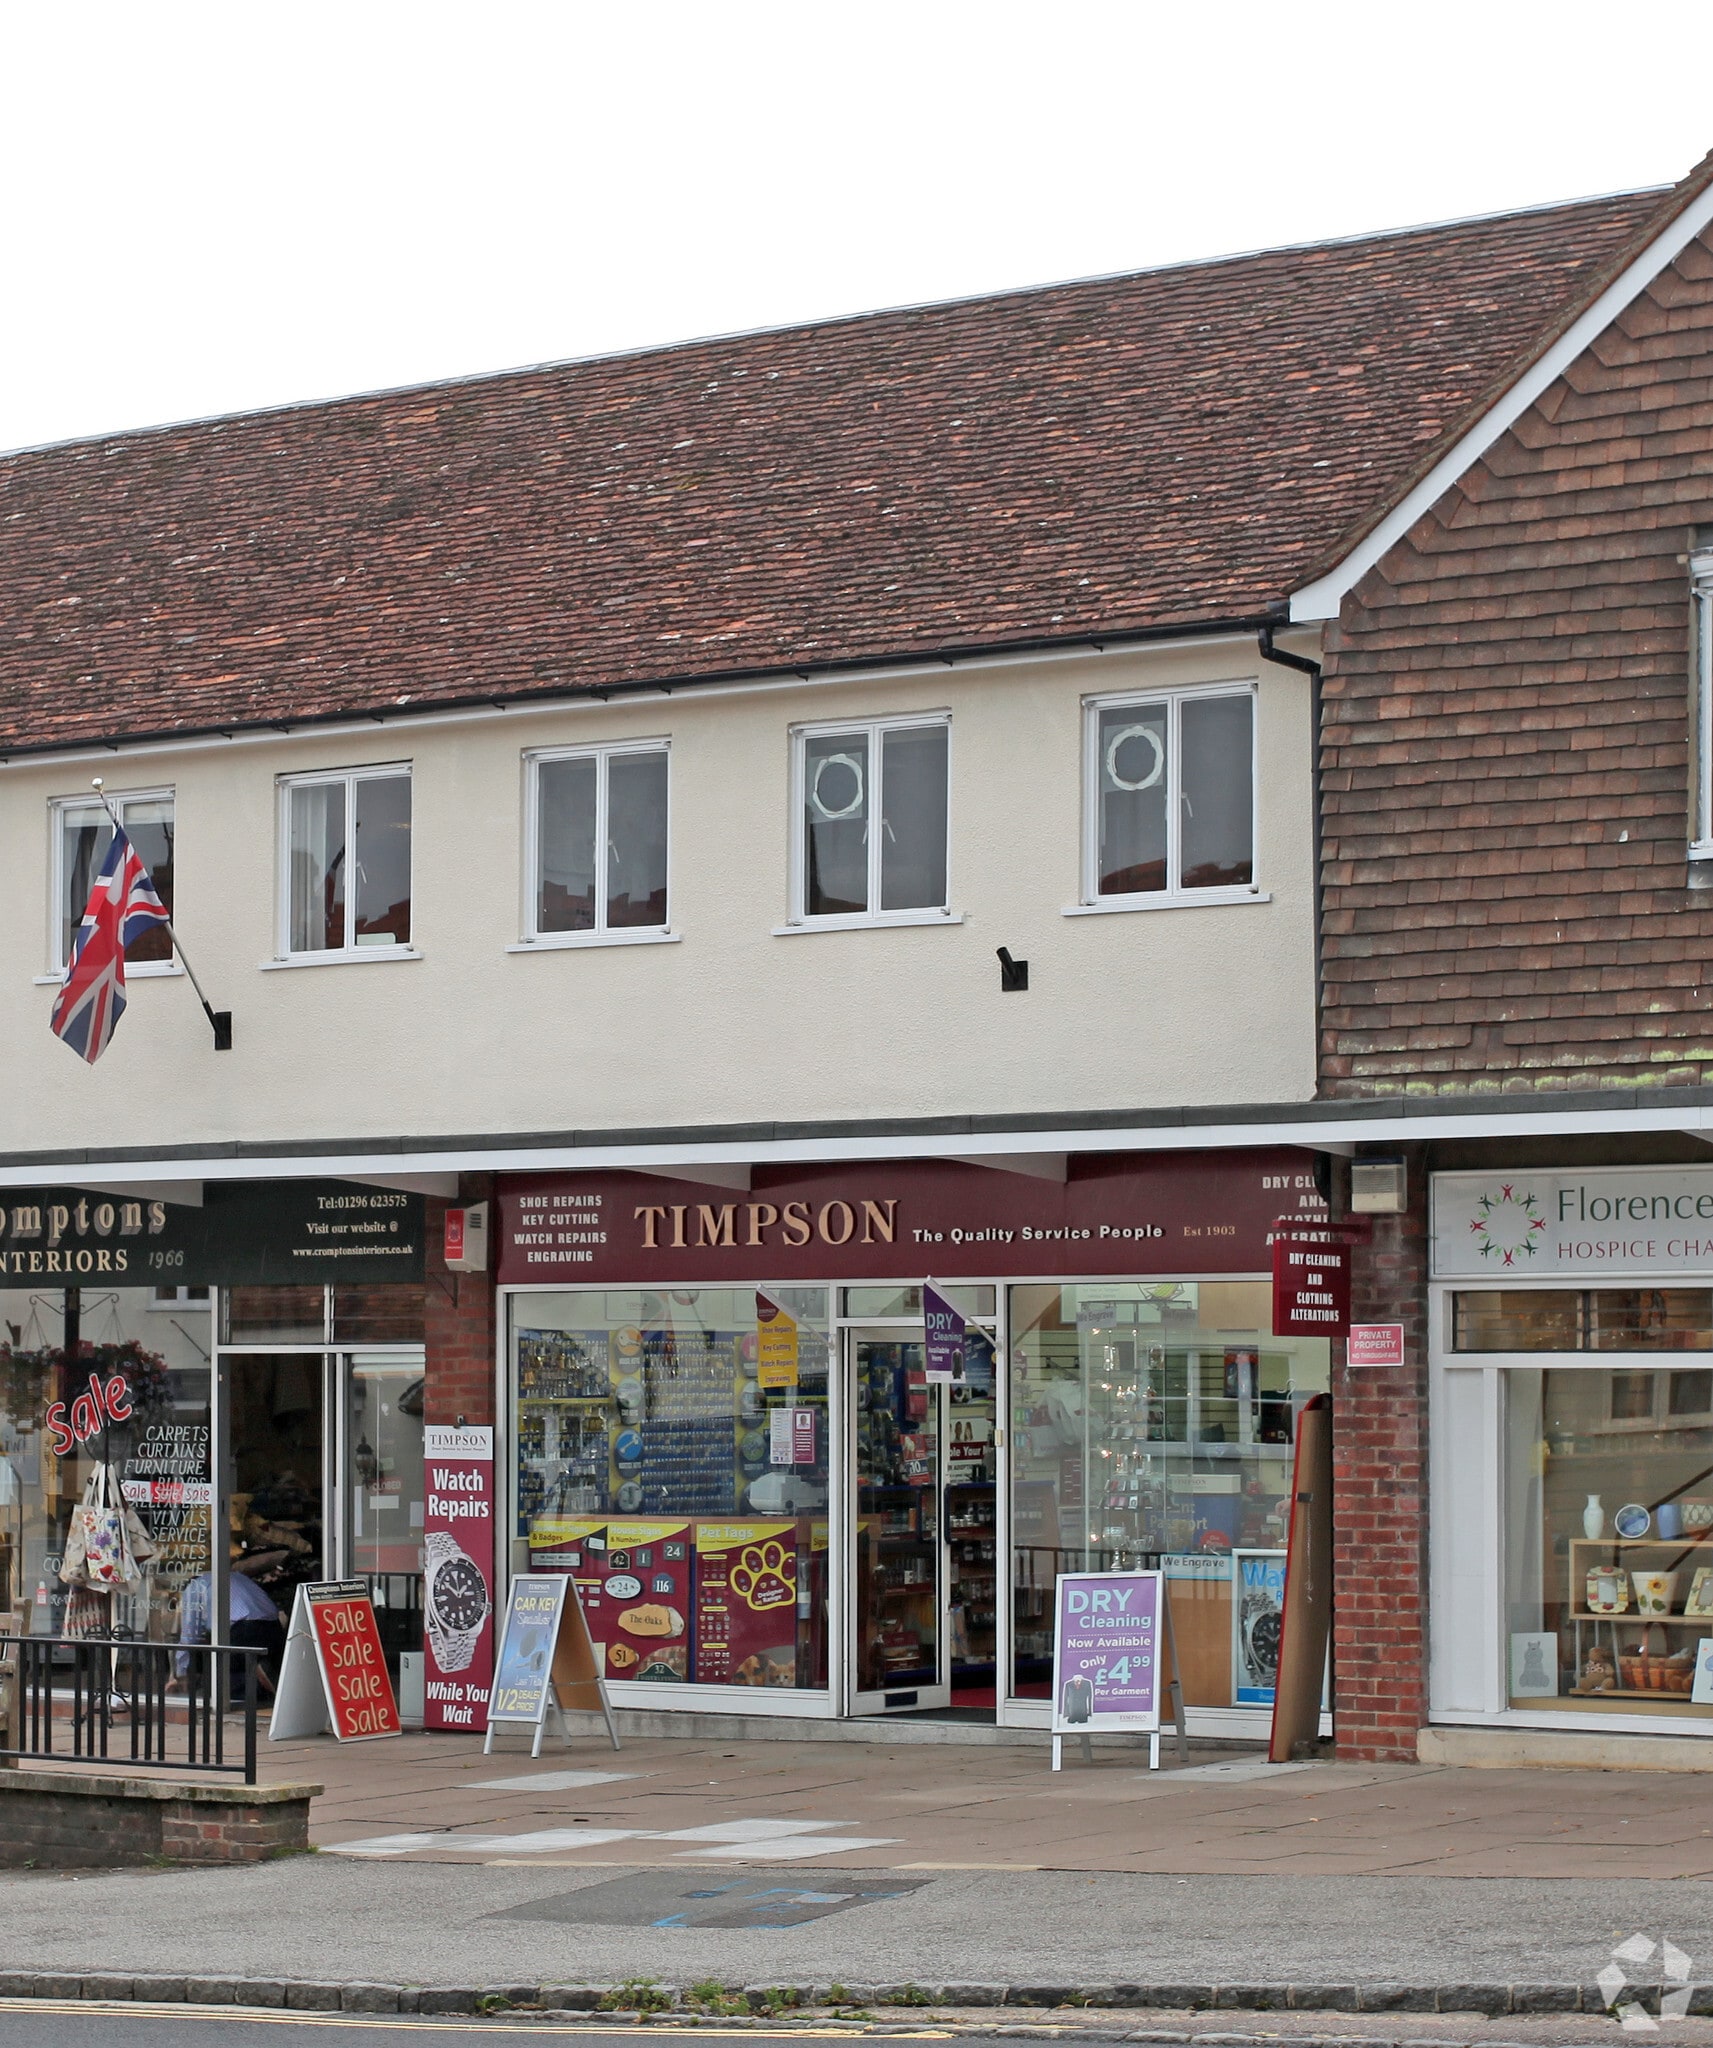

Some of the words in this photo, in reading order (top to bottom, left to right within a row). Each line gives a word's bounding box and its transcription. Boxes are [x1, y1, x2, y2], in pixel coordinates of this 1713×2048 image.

[1262, 1176, 1290, 1189] DRY
[317, 1196, 368, 1209] Tel:01296
[370, 1195, 408, 1207] 623575
[520, 1197, 548, 1208] SHOE
[553, 1195, 602, 1207] REPAIRS
[1558, 1186, 1713, 1222] Florence
[522, 1214, 544, 1225] KEY
[550, 1213, 599, 1225] CUTTING
[633, 1200, 900, 1248] TIMPSON
[306, 1222, 329, 1234] Visit
[331, 1224, 348, 1234] our
[350, 1221, 386, 1233] website
[389, 1220, 398, 1233] @
[913, 1229, 943, 1242] The
[951, 1228, 1014, 1244] Quality
[1022, 1227, 1091, 1240] Service
[1100, 1224, 1163, 1241] People
[1183, 1226, 1201, 1237] Est
[1205, 1225, 1236, 1236] 1903
[514, 1233, 552, 1244] WATCH
[558, 1232, 607, 1243] REPAIRS
[292, 1245, 413, 1258] www.cromptonsinteriors.co.uk
[1558, 1240, 1656, 1259] HOSPICE
[1667, 1239, 1713, 1258] CHA
[150, 1250, 184, 1269] 1966
[528, 1251, 593, 1262] ENGRAVING
[1289, 1253, 1304, 1265] DRY
[1306, 1254, 1341, 1267] CLEANING
[1307, 1273, 1323, 1285] AND
[1297, 1292, 1333, 1305] CLOTHING
[927, 1313, 953, 1330] DRY
[1290, 1309, 1339, 1322] ALTERATIONS
[933, 1332, 962, 1343] Cleaning
[1358, 1331, 1391, 1340] PRIVATE
[1354, 1340, 1397, 1349] PROPERTY
[46, 1373, 132, 1455] Sale
[146, 1426, 208, 1441] CARPETS
[430, 1434, 487, 1446] TIMPSON
[138, 1443, 206, 1458] CURTAINS
[963, 1446, 981, 1456] Your
[124, 1459, 205, 1475] FURNITURE
[432, 1468, 484, 1491] Watch
[428, 1494, 489, 1522] Repairs
[153, 1510, 207, 1526] VINYLS
[152, 1527, 207, 1542] SERVICE
[700, 1527, 720, 1538] Pet
[725, 1527, 754, 1540] Tags
[641, 1553, 646, 1564] 1
[666, 1546, 681, 1557] 24
[614, 1555, 625, 1565] 42
[1163, 1557, 1180, 1566] We
[1182, 1557, 1224, 1569] Engrave
[618, 1582, 628, 1592] 24
[655, 1581, 670, 1592] 116
[514, 1597, 536, 1611] CAR
[539, 1597, 558, 1611] KEY
[1068, 1588, 1134, 1614] DRY
[323, 1603, 367, 1635] Sale
[629, 1614, 642, 1624] The
[645, 1616, 663, 1625] Oaks
[1080, 1614, 1151, 1629] Cleaning
[1067, 1639, 1093, 1648] Now
[1097, 1636, 1151, 1647] Available
[330, 1636, 375, 1668] Sale
[615, 1649, 626, 1663] 51
[1080, 1655, 1107, 1669] Only
[654, 1665, 665, 1674] 32
[1095, 1655, 1151, 1686] £4.99
[338, 1669, 383, 1701] Sale
[427, 1682, 463, 1701] While
[466, 1684, 489, 1702] You
[1095, 1688, 1109, 1696] Per
[1111, 1687, 1150, 1696] Garment
[497, 1688, 518, 1711] 1/2
[518, 1690, 542, 1700] DEALER
[345, 1701, 390, 1734] Sale
[443, 1705, 473, 1724] Wait
